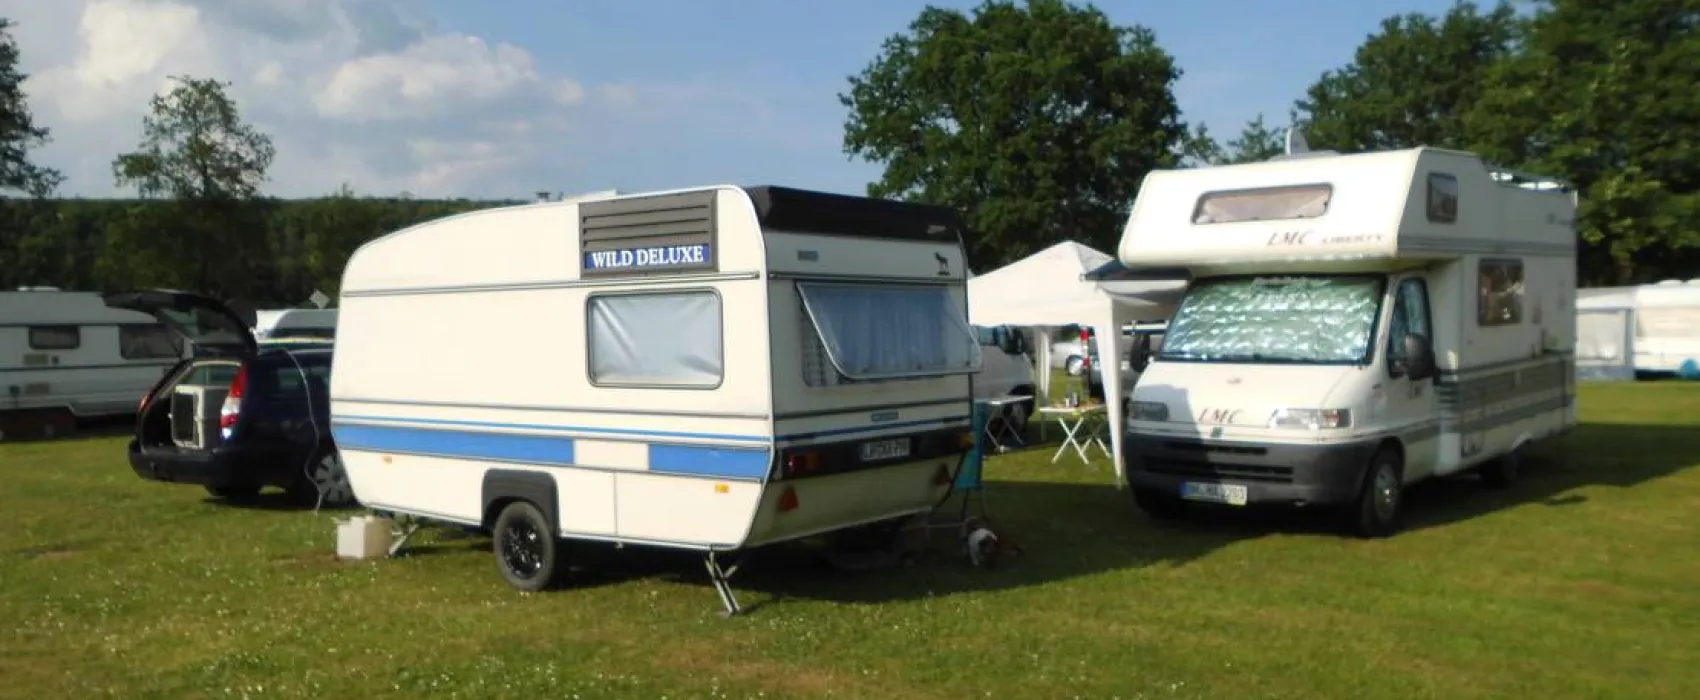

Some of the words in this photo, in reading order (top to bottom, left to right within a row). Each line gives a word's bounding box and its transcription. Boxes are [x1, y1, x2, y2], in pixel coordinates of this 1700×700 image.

[1267, 230, 1314, 246] LMC
[592, 249, 633, 268] WILD
[636, 246, 704, 266] DELUXE
